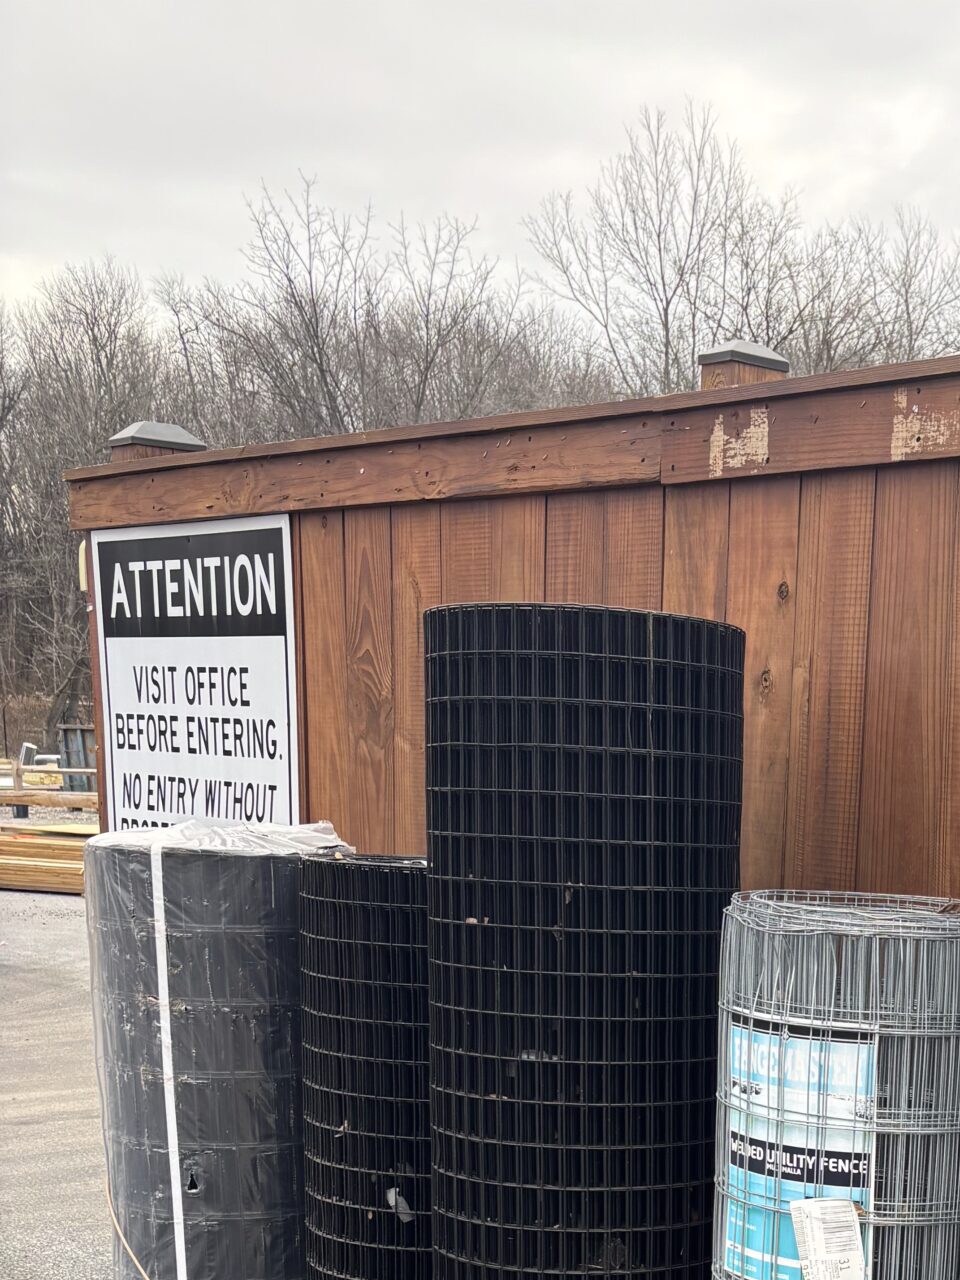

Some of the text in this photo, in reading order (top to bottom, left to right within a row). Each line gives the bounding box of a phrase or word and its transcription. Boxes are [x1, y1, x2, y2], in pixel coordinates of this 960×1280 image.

[110, 552, 277, 619] ATTENTION
[133, 666, 250, 707] VISIT OFFICE
[115, 713, 283, 760] BEFORE ENTERING.
[123, 773, 277, 823] NO ENTRY WITHOUT
[820, 1157, 868, 1175] FENCE
